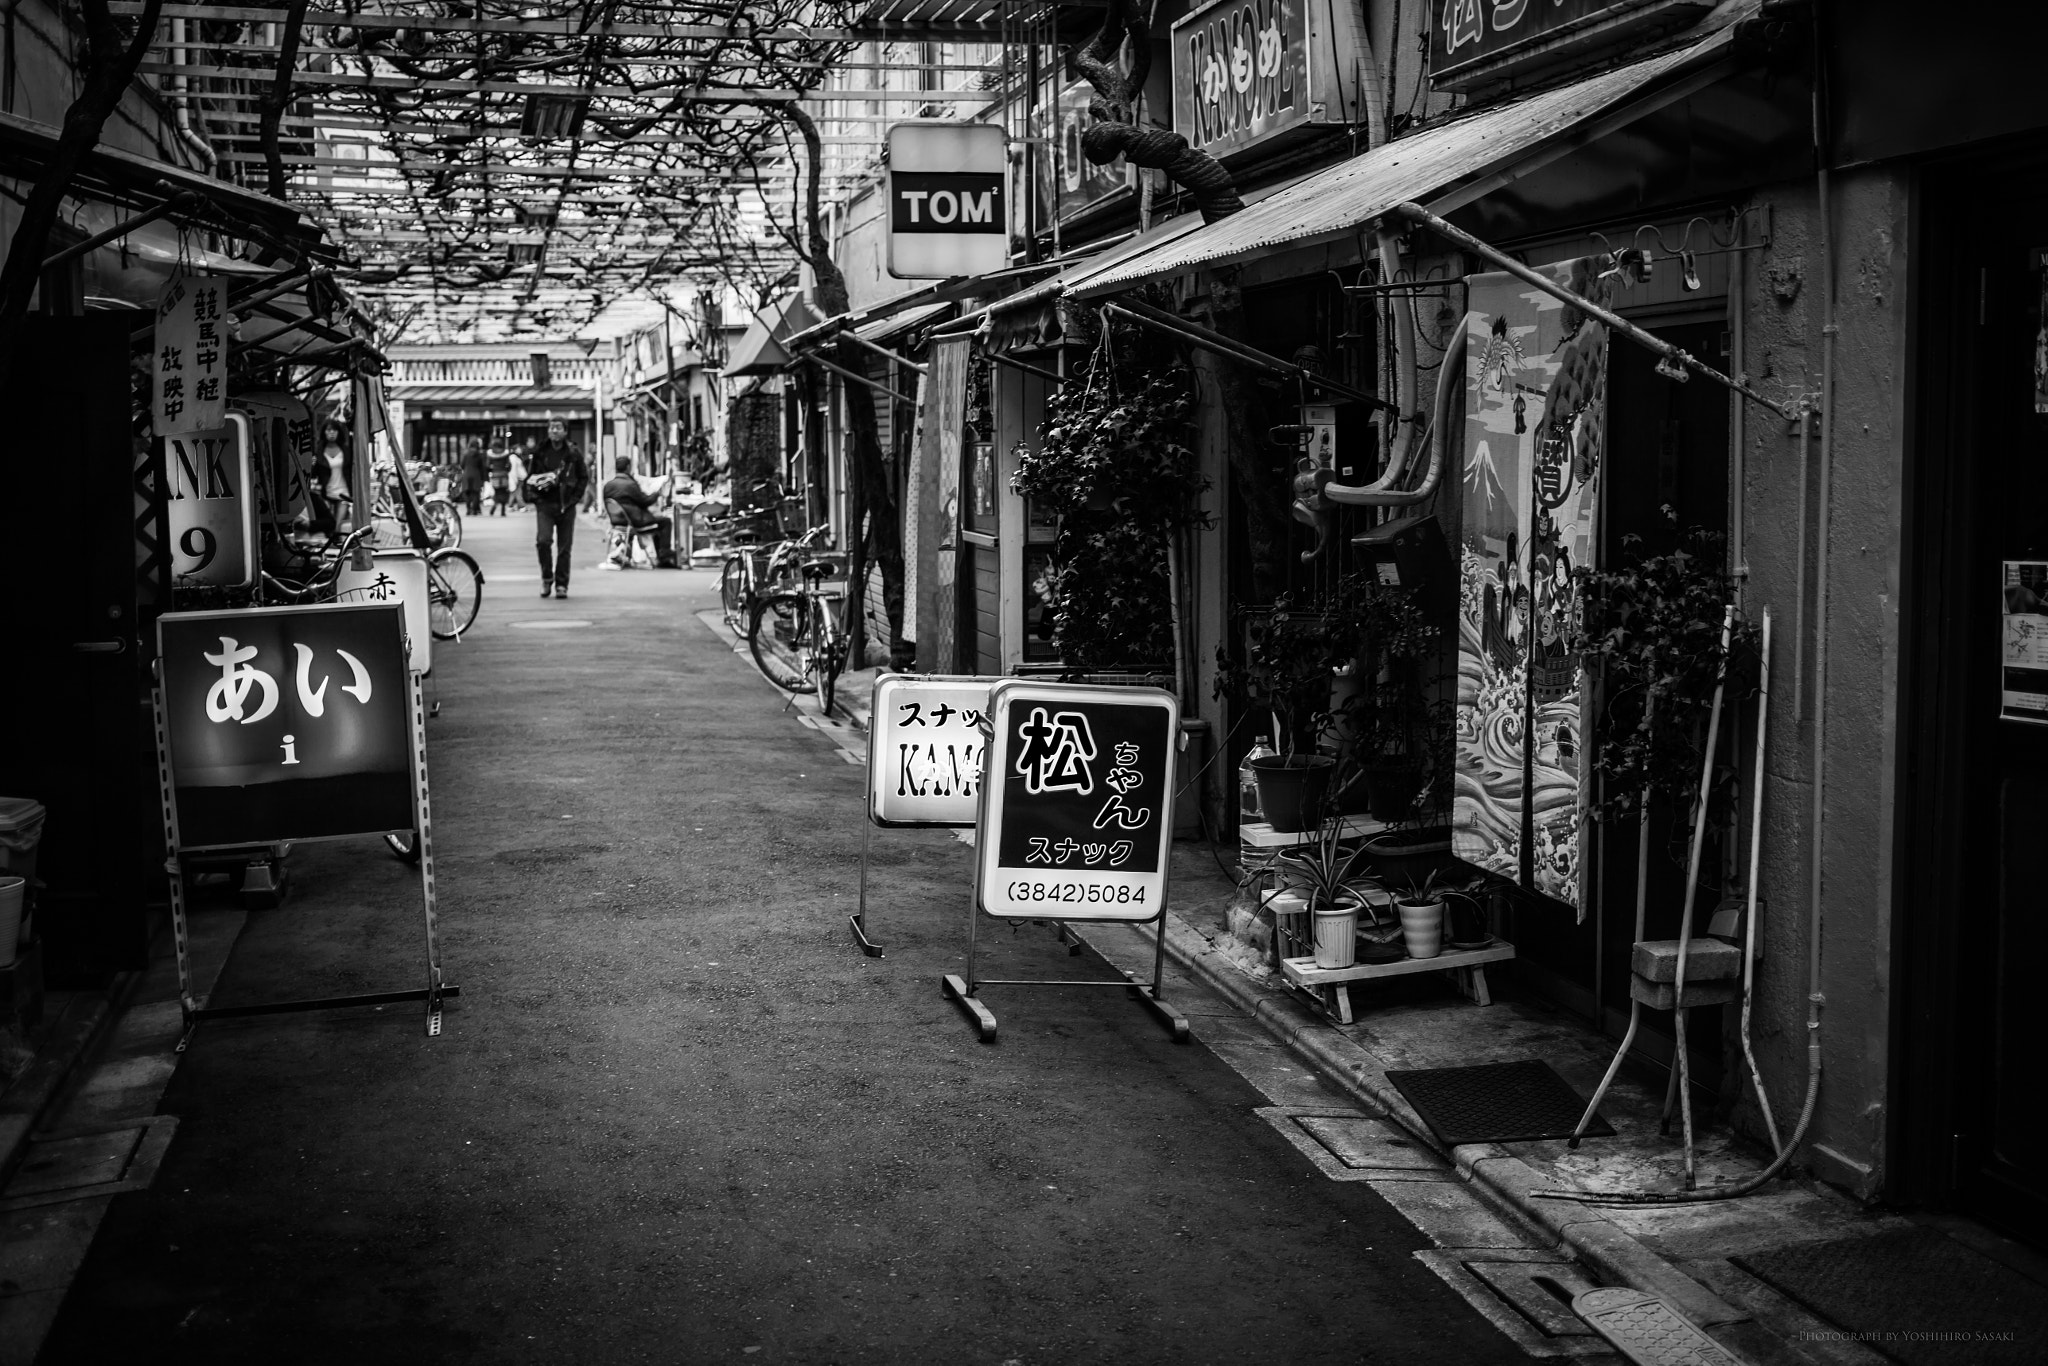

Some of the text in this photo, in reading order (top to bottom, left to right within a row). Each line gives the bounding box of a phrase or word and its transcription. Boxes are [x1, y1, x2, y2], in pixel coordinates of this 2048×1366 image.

[1203, 17, 1282, 104] かもめ
[194, 287, 221, 401] 競馬中継
[161, 346, 184, 422] 放映中
[168, 439, 234, 501] NK
[368, 572, 396, 601] 赤
[203, 636, 373, 724] あい
[280, 734, 301, 765] i
[1025, 837, 1134, 866] スナック
[1007, 880, 1146, 905] (3842)5084
